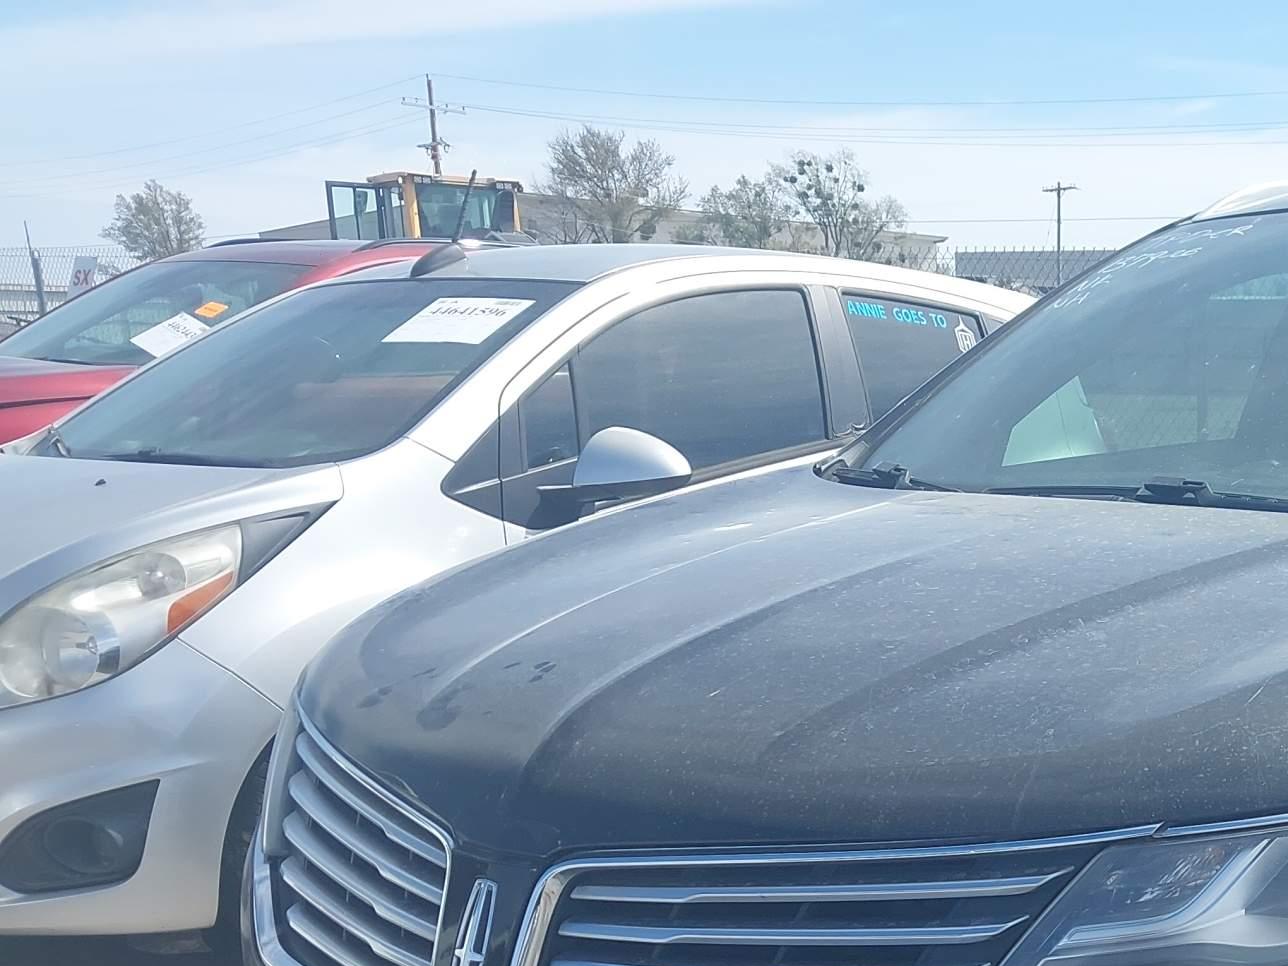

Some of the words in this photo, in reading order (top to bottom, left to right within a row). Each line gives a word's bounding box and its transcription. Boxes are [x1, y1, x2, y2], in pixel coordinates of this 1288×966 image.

[847, 300, 887, 319] ANNIE
[892, 307, 927, 325] GOES
[929, 313, 947, 328] TO
